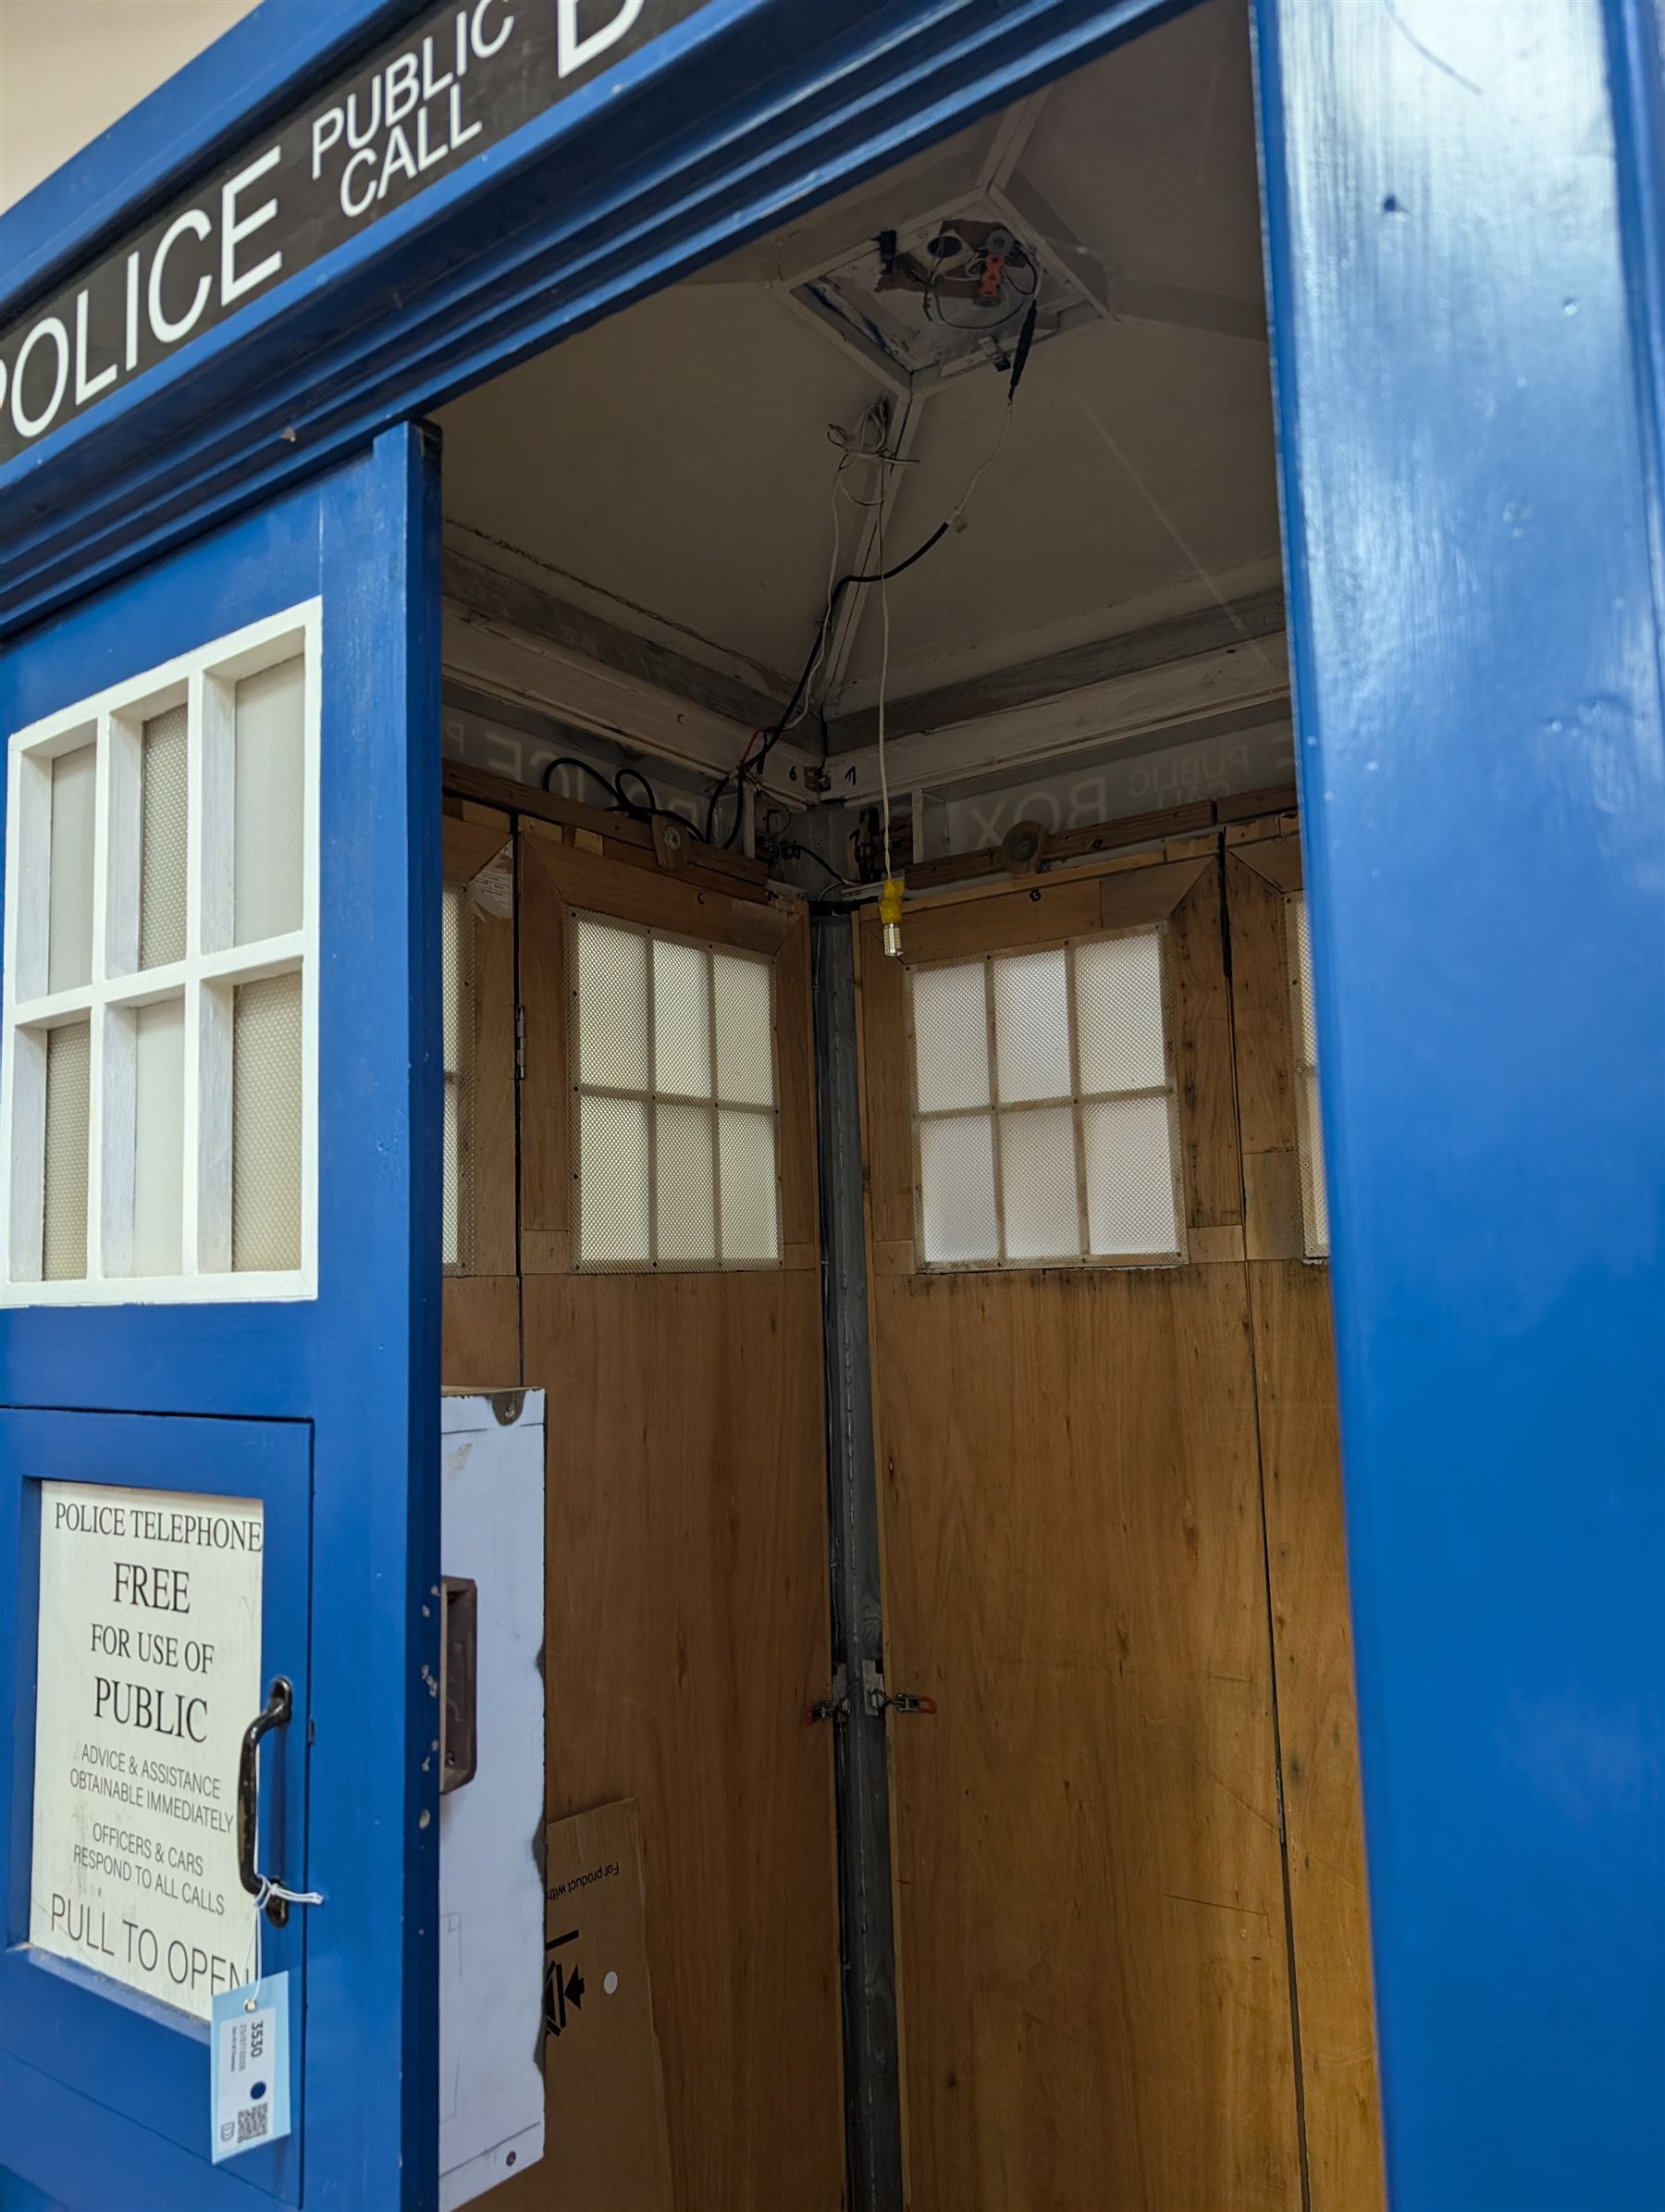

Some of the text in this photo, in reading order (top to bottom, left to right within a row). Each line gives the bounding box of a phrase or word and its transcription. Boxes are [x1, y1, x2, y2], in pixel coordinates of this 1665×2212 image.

[311, 0, 515, 180] PUBLIC
[339, 84, 482, 217] CALL
[0, 145, 282, 439] OLICE
[55, 1501, 263, 1552] POLICE TELEPHONE
[113, 1562, 191, 1613] FREE
[91, 1623, 215, 1674] FOR USE OF
[93, 1675, 208, 1743] PUBLIC
[81, 1743, 221, 1800] ADVICE & ASSISTANCE
[69, 1768, 234, 1834] OBTAINABLE IMMEDIATELY
[92, 1822, 204, 1877] OFFICERS & CARS
[604, 1860, 620, 1876] For
[73, 1844, 225, 1916] RESPOND TO ALL CALLS
[567, 1866, 603, 1893] product
[51, 1893, 115, 1957] PULL
[122, 1920, 158, 1971] TO
[251, 2020, 264, 2058] 3530
